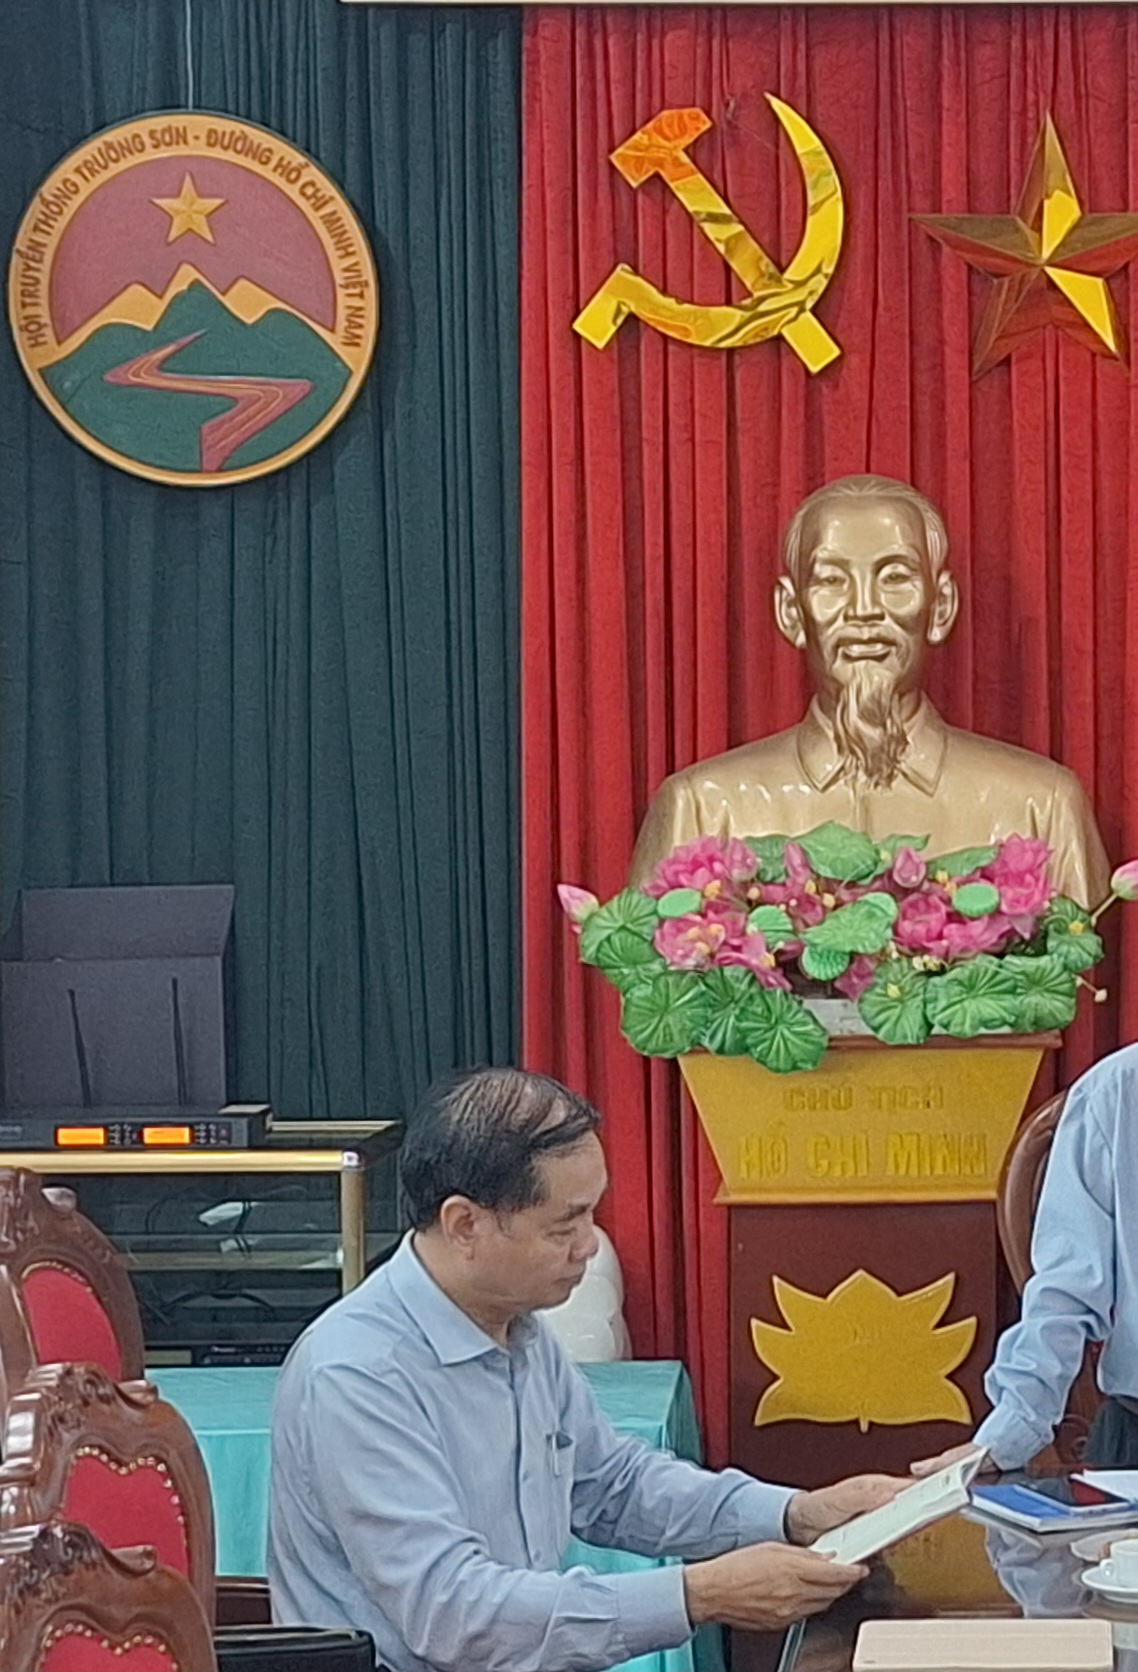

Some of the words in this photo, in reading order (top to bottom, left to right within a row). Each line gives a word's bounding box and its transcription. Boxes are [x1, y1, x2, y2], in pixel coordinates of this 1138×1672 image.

[148, 125, 189, 150] SƠN
[206, 128, 274, 166] ĐƯỜNG
[33, 178, 80, 237] THỐNG
[299, 179, 337, 212] CHÍ
[319, 209, 357, 260] MINH
[339, 261, 369, 300] VIỆT
[20, 314, 48, 348] HỘI
[340, 304, 366, 348] NAM
[885, 1132, 989, 1178] MINH
